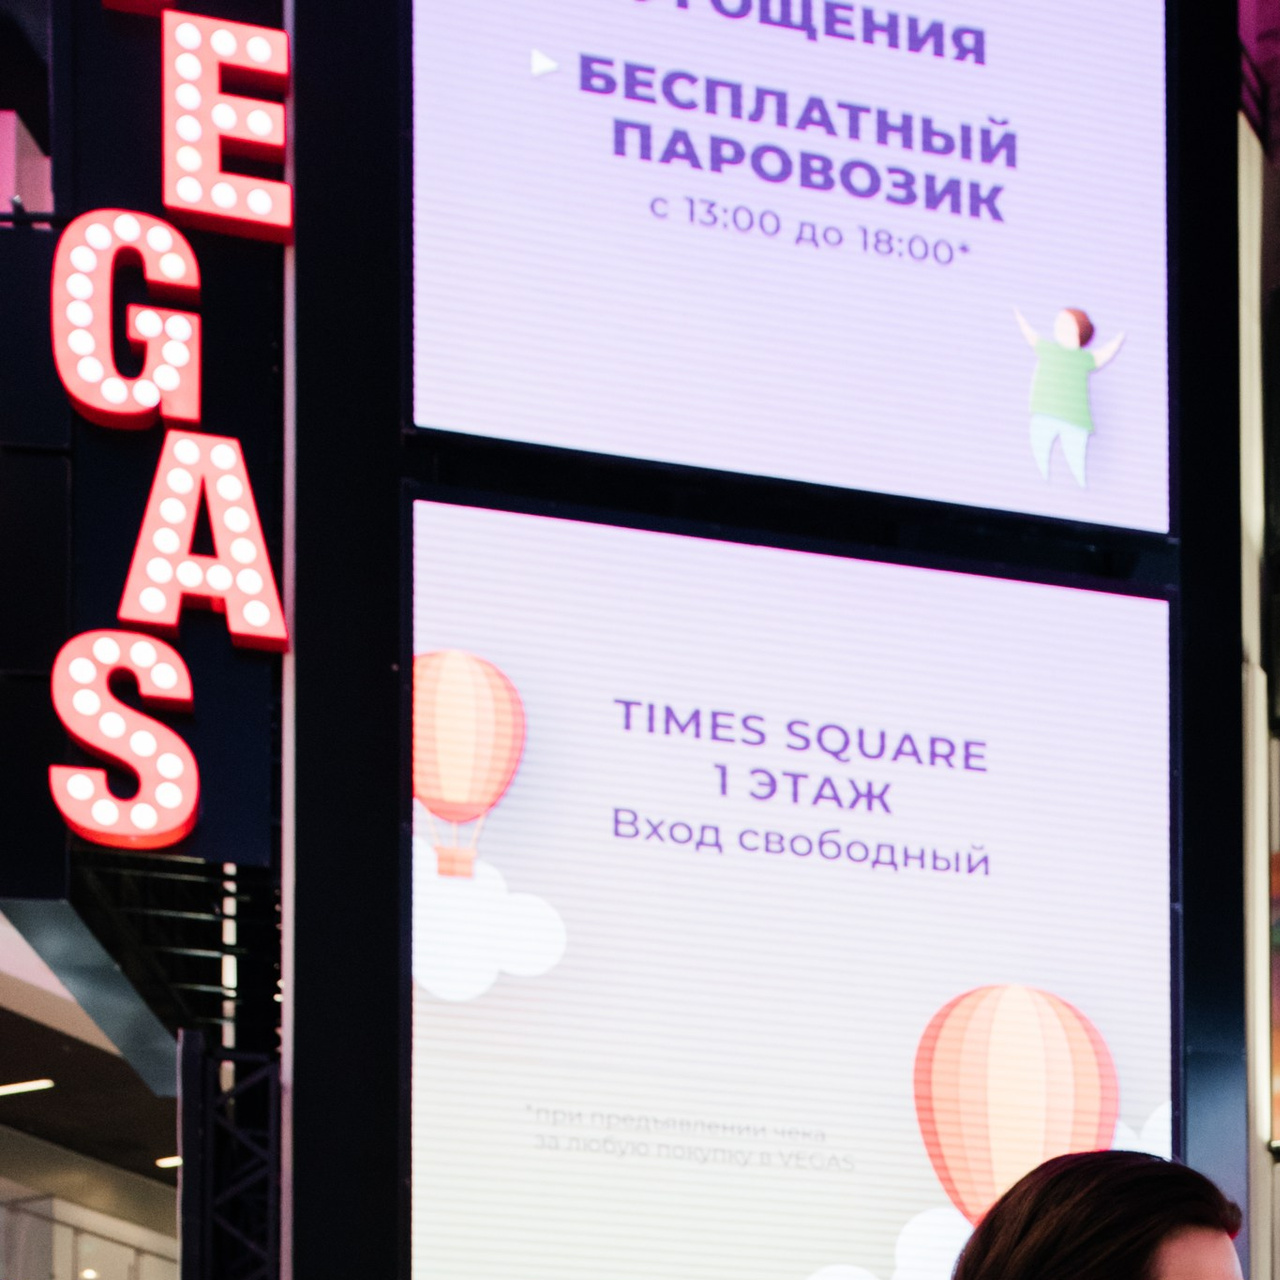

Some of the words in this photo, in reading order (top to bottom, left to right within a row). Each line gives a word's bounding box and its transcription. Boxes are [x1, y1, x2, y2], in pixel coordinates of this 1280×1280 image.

[635, 0, 987, 65] ЩЕНИЯ
[578, 52, 1018, 169] БЕСПЛАТНЫЙ
[612, 117, 1006, 222] ПАРОВОЗИК
[684, 195, 781, 237] 13:00
[794, 220, 844, 249] до
[50, 0, 294, 850] EGAS
[613, 698, 767, 747] TIMES
[785, 719, 989, 773] SQUARE
[713, 763, 728, 797] 1
[748, 768, 892, 815] ЭТАЖ
[612, 806, 724, 854] Вход
[737, 829, 991, 877] свободный
